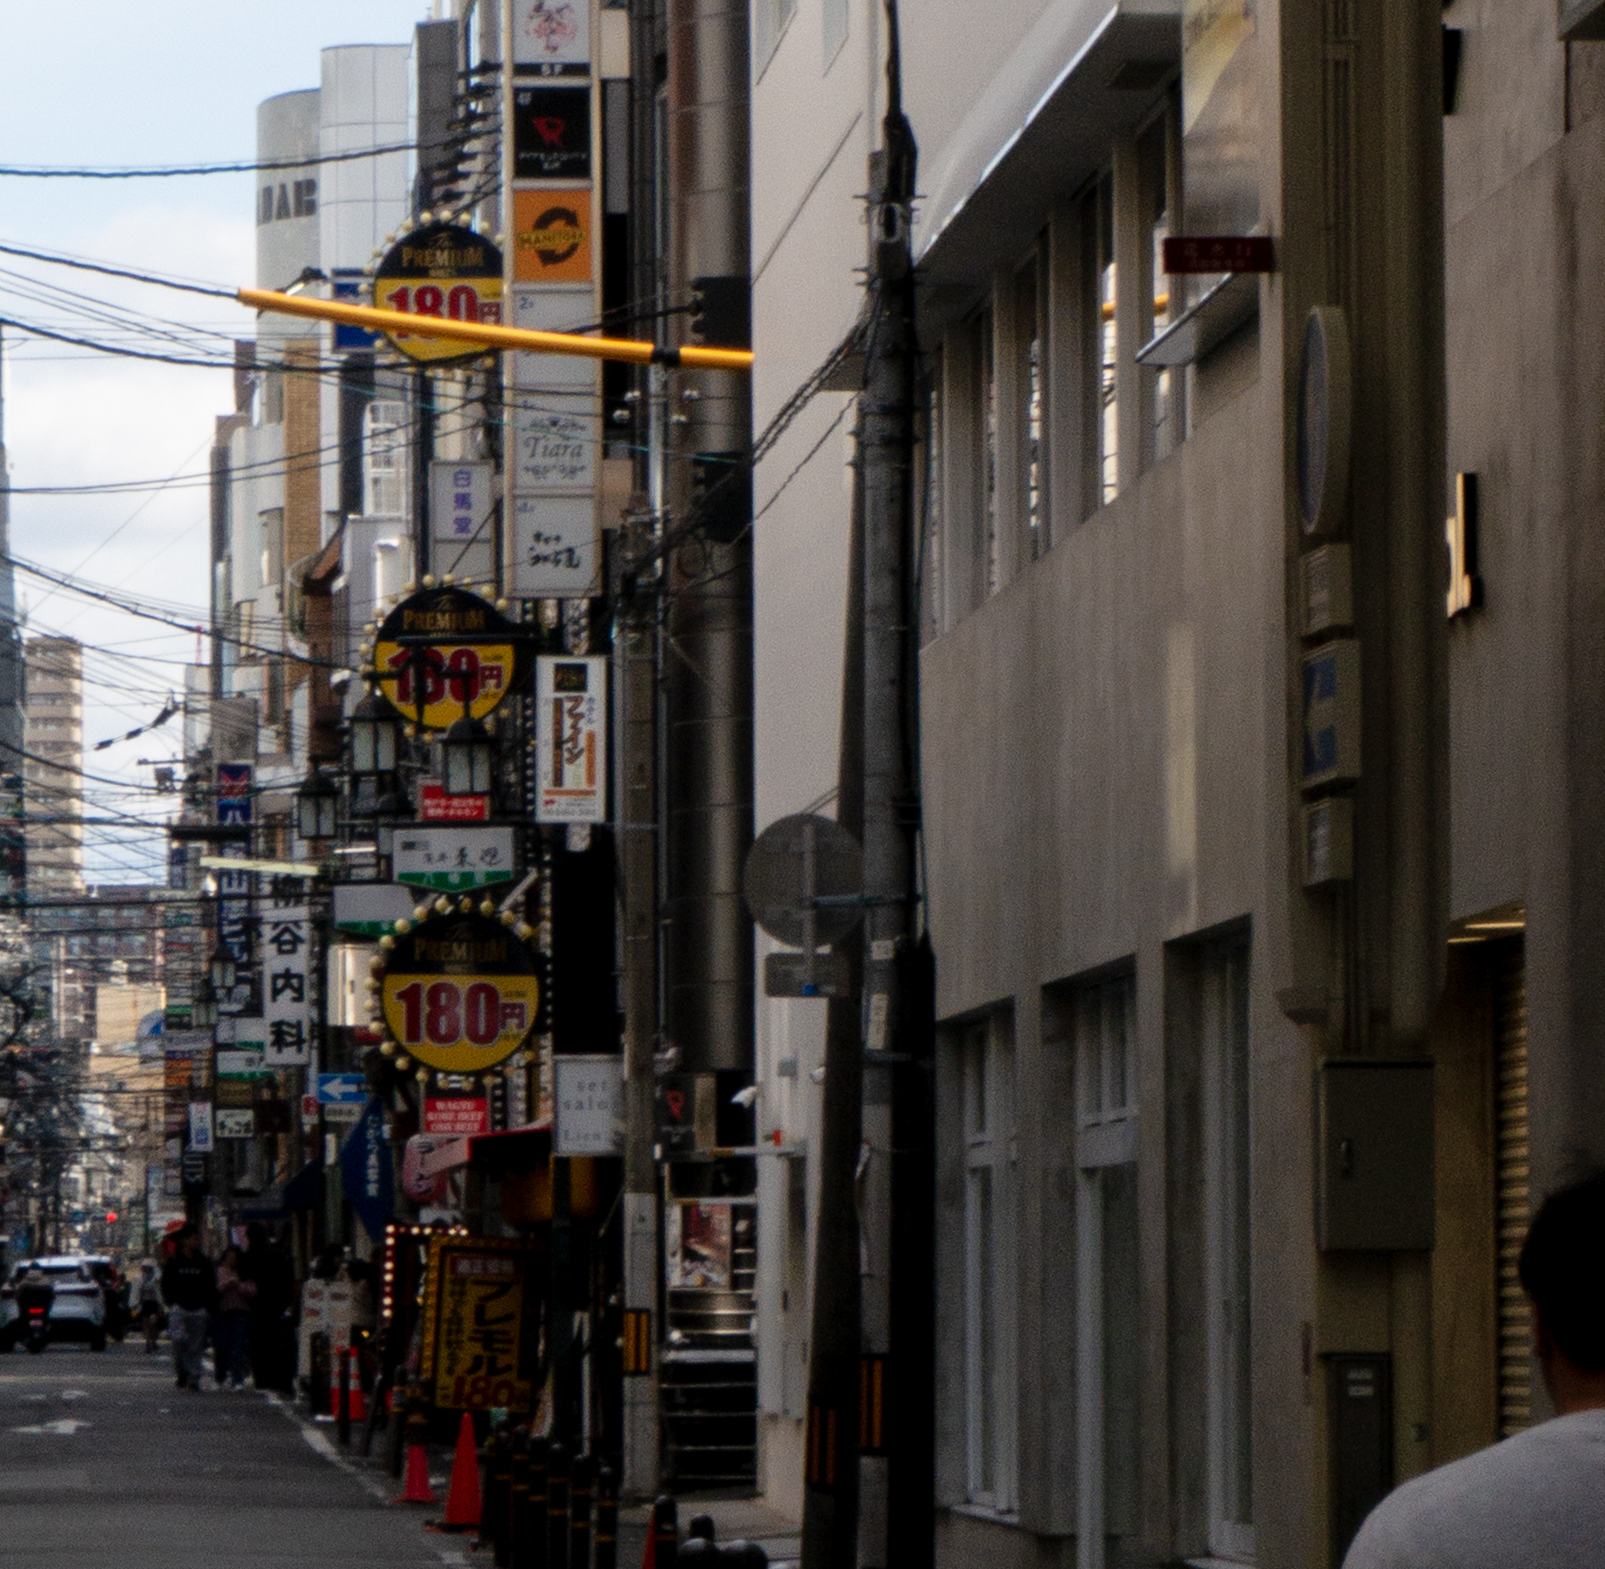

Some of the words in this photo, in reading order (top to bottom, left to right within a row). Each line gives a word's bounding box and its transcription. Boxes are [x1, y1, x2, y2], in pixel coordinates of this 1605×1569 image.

[401, 245, 485, 268] PREMIUM
[523, 435, 584, 459] Tiara
[402, 608, 487, 631] PREMIUM
[414, 937, 508, 963] PREMIUM
